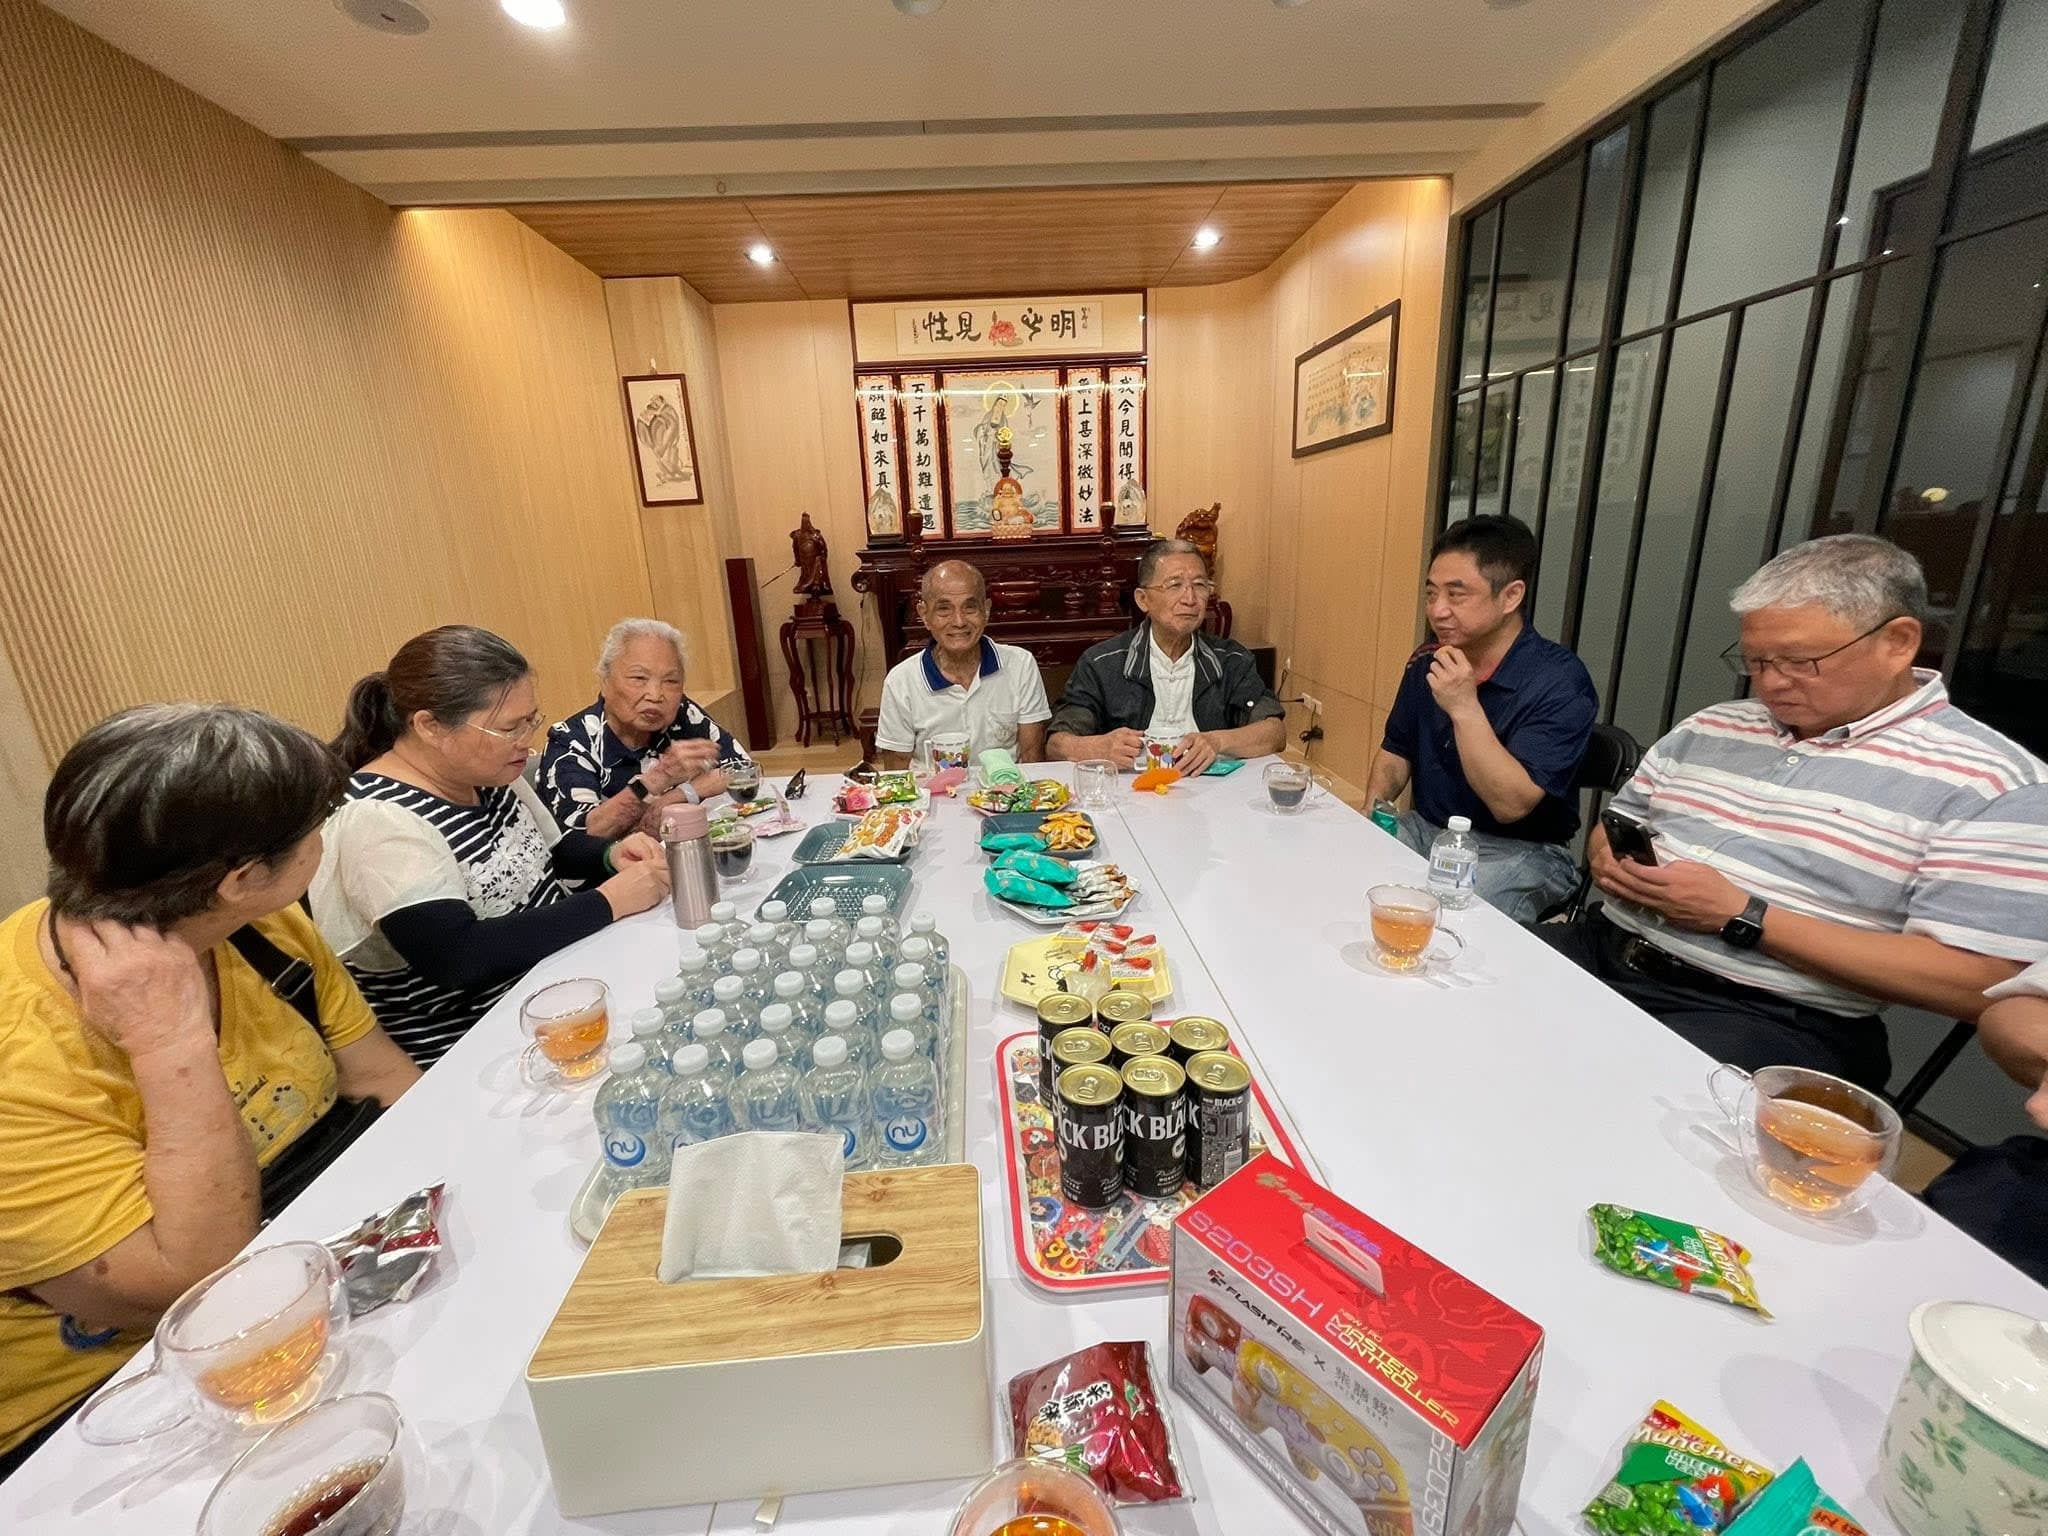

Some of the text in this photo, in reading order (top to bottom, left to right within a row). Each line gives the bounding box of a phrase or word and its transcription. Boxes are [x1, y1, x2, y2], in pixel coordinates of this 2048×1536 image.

[868, 385, 891, 489] 願解如來真
[1118, 376, 1135, 481] 我今見聞得
[1188, 1210, 1324, 1318] S203SH
[1226, 1285, 1306, 1354] FLASHFIRE
[1330, 1314, 1419, 1384] MASTER
[1324, 1321, 1460, 1429] CONTROLLER
